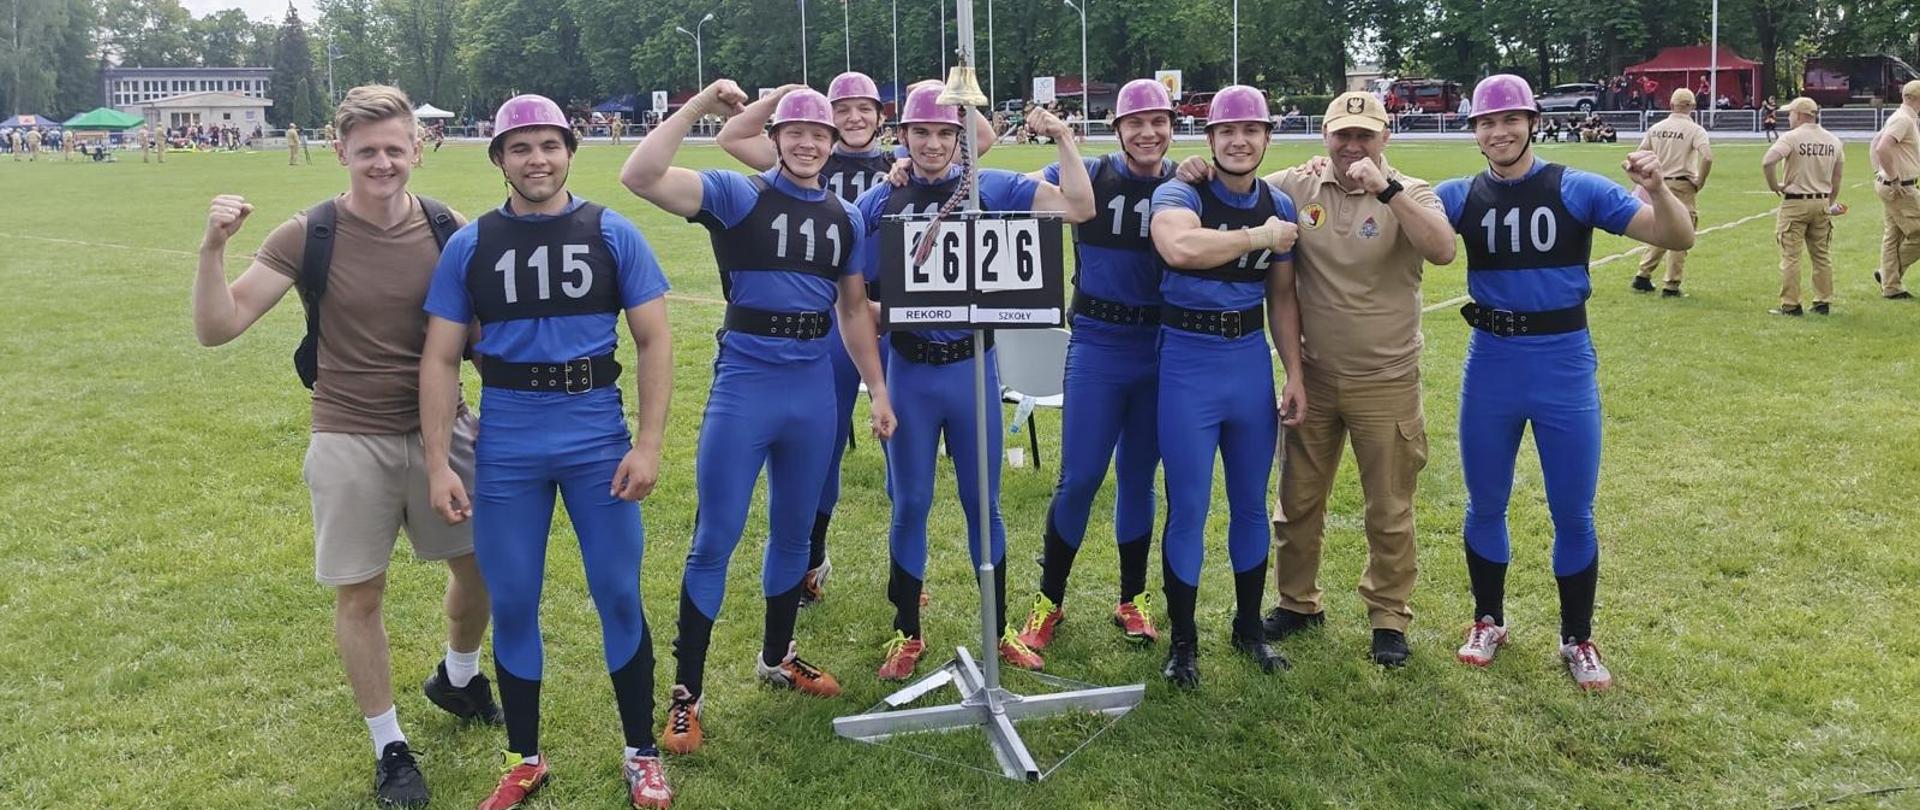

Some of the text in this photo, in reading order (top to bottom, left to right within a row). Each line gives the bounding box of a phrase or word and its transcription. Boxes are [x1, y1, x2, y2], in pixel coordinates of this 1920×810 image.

[830, 171, 888, 199] 11
[771, 213, 841, 267] 111
[1481, 206, 1557, 253] 110
[495, 244, 593, 303] 115
[982, 229, 1032, 282] 26
[906, 310, 1032, 320] REKORD SZKOŁY
